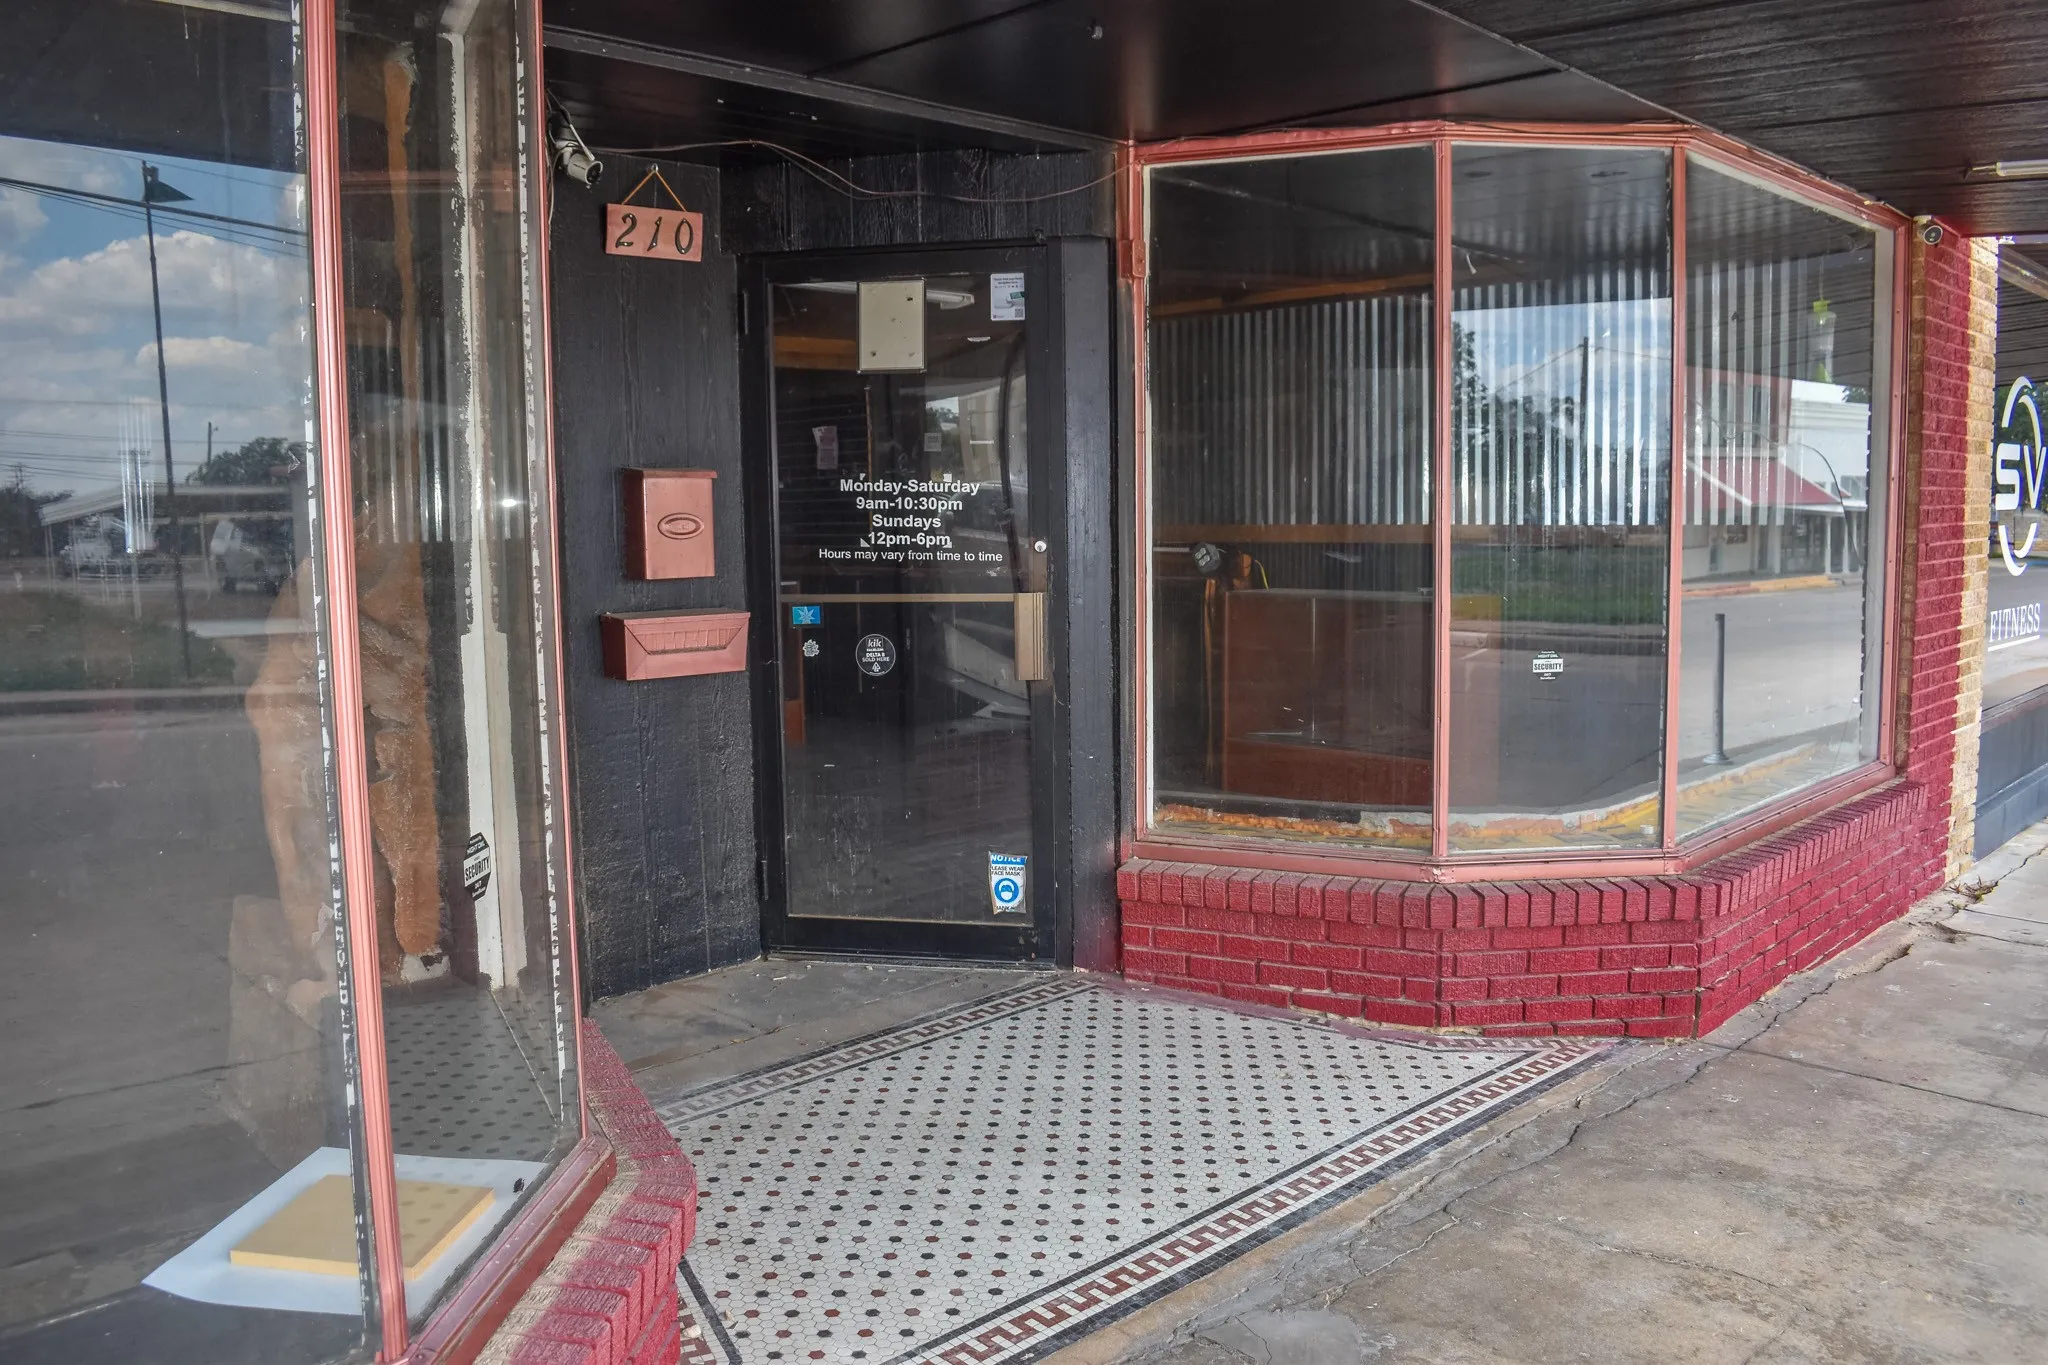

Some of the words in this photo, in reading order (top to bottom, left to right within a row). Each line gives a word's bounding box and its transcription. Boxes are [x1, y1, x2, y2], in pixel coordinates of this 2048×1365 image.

[615, 213, 694, 255] 210
[840, 479, 980, 496] Monday-Saturday
[856, 496, 963, 512] 9am-10:30pm
[872, 514, 942, 531] Sundays
[868, 532, 951, 548] 12pm-6pm
[818, 548, 851, 560] Hours
[854, 551, 878, 562] may
[880, 551, 905, 562] vary
[907, 549, 934, 561] from
[936, 550, 961, 562] time
[964, 551, 976, 562] to
[978, 551, 1003, 562] time
[1989, 603, 2040, 643] FITNESS
[867, 638, 882, 647] kik
[465, 856, 490, 881] SECURITY
